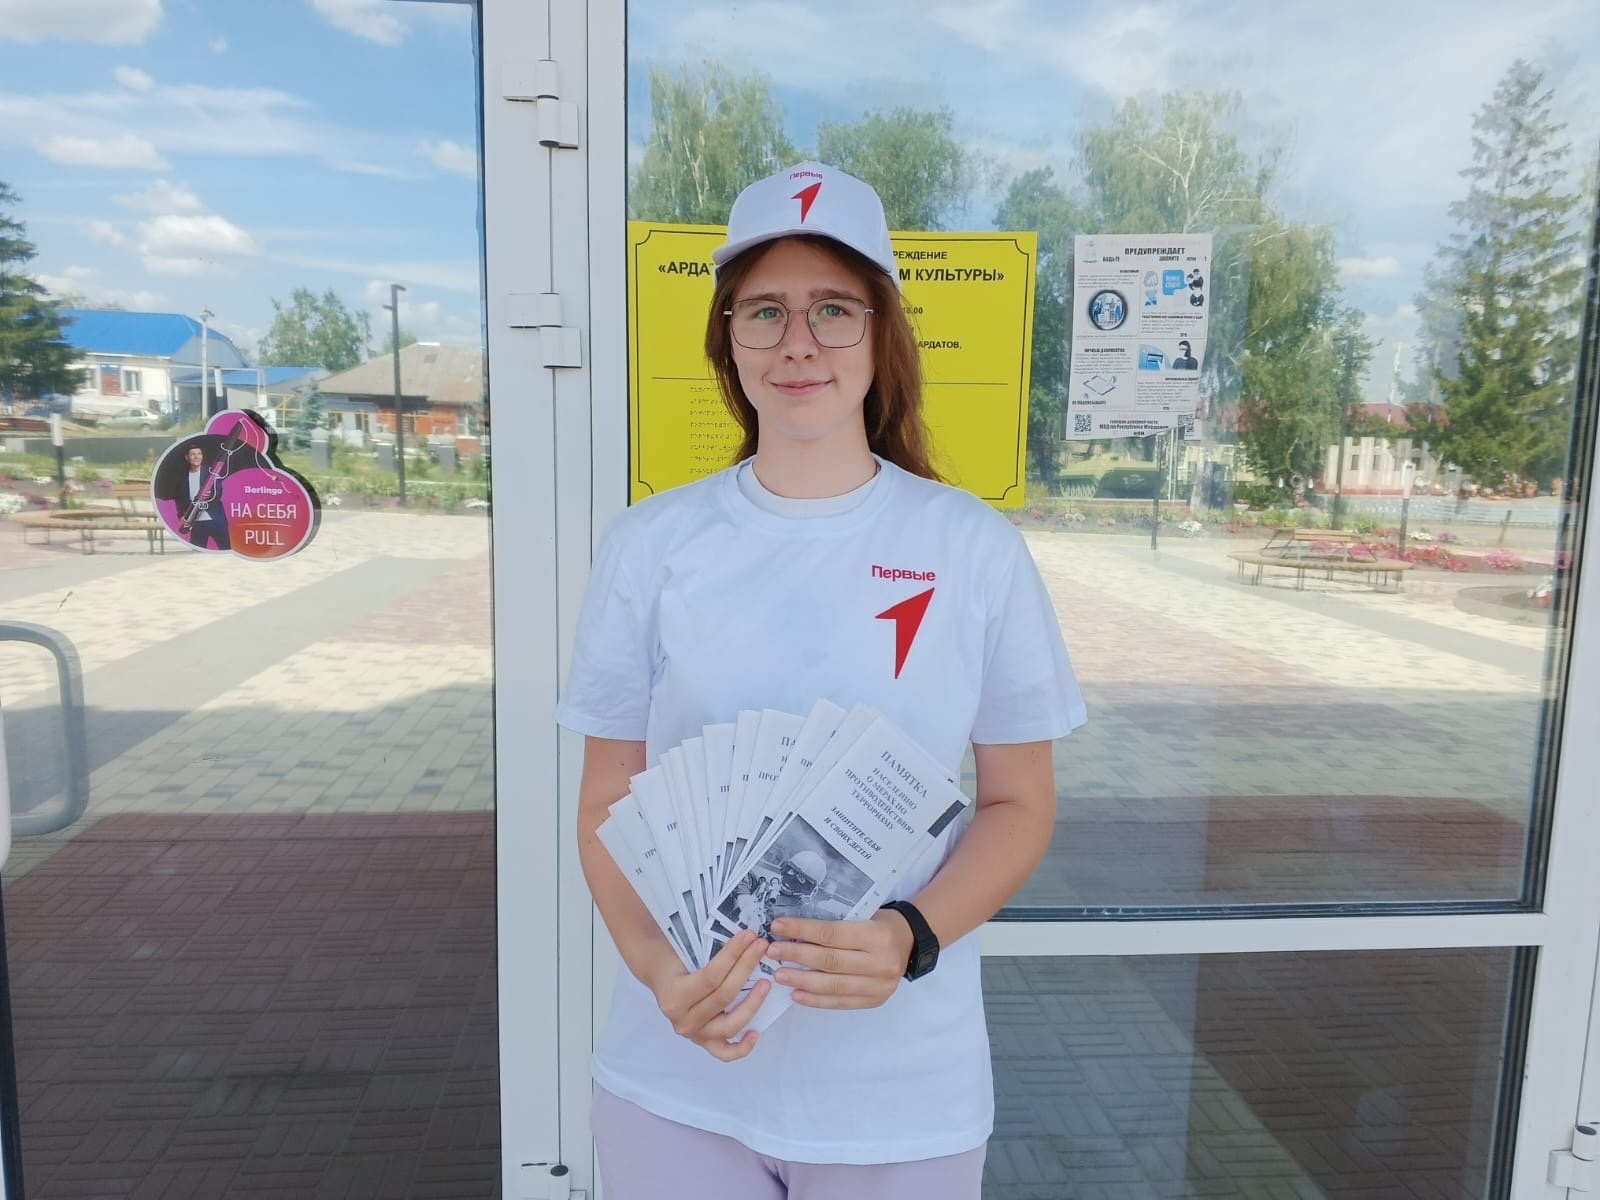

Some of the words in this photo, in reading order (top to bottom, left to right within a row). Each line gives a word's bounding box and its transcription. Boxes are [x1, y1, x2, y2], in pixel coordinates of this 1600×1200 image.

[789, 171, 823, 180] Первые
[1124, 247, 1185, 255] ПРЕДУПРЕЖДАЕТ
[658, 261, 714, 277] «АРДА
[915, 268, 1005, 281] КУЛЬТУРЫ»
[918, 340, 962, 350] АРДАТОВ,
[243, 485, 284, 496] Berlingo
[230, 502, 252, 518] НА
[256, 503, 297, 519] СЕБЯ
[244, 529, 285, 546] PULL
[872, 564, 936, 582] Первые
[880, 749, 928, 798] ПАМЯТКА
[866, 775, 873, 783] О
[873, 781, 895, 805] МЕРАХ
[895, 801, 908, 815] ПО
[872, 767, 917, 810] НАСЕЛЕНИЮ
[852, 789, 894, 830] ТЕРРОРИЗМУ
[830, 823, 852, 846] СВОИХ
[848, 840, 872, 860] ДЕТЕЙ
[863, 836, 882, 852] СЕБЯ
